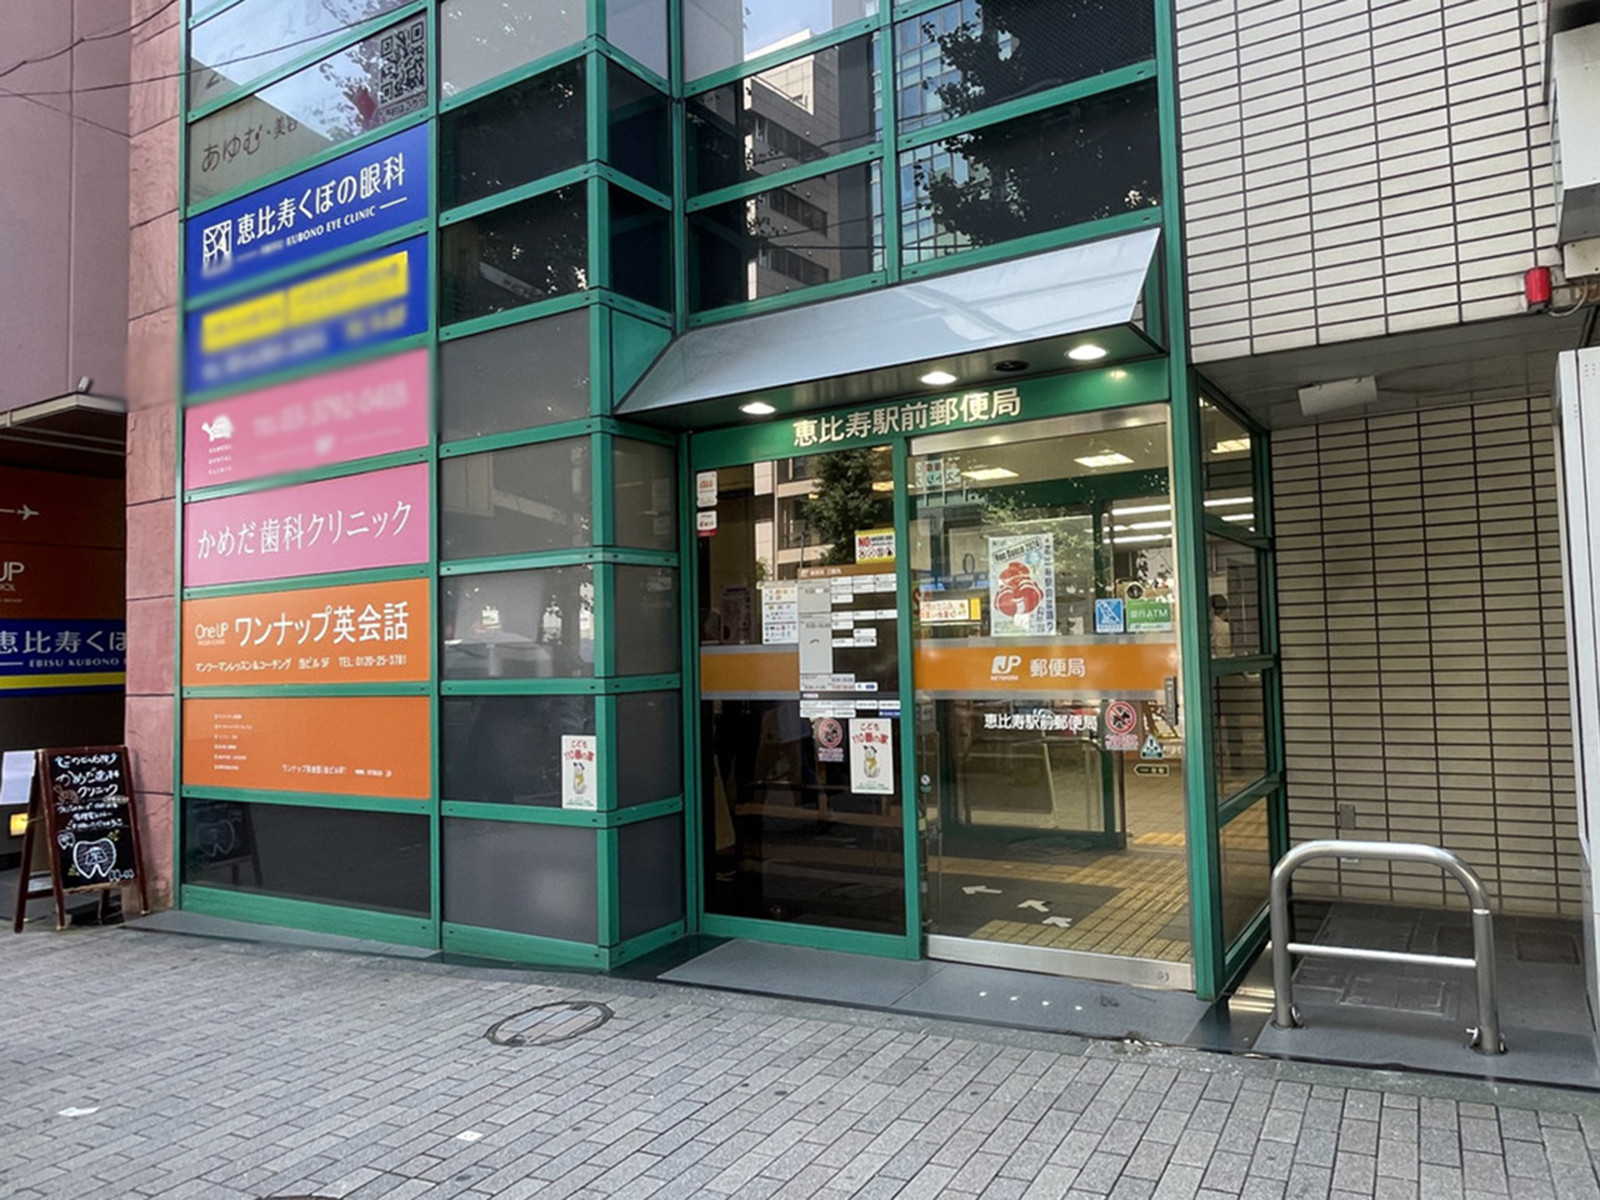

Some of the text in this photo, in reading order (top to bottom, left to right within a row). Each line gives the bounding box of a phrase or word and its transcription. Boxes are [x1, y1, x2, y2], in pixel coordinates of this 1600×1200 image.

[237, 153, 405, 245] 恵比寿くぼの眼科
[326, 217, 342, 232] EYE
[344, 206, 376, 226] CLINIC
[792, 387, 1021, 447] 恵比寿駅前郵便局
[197, 500, 412, 559] かめだ歯科クリニック
[235, 601, 409, 647] ワンナップ英会話
[29, 659, 64, 669] EBISU
[1030, 658, 1085, 677] 郵便局
[984, 713, 1098, 733] 恵比寿駅前郵便局
